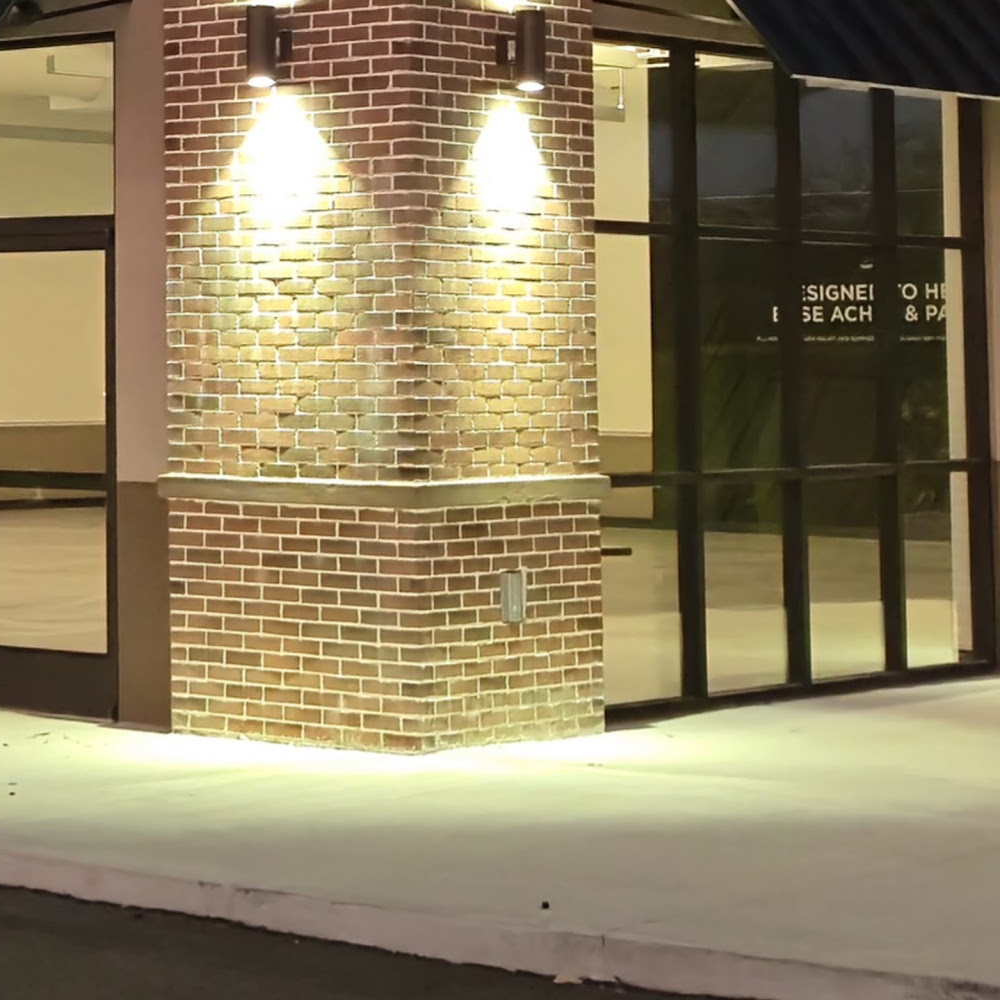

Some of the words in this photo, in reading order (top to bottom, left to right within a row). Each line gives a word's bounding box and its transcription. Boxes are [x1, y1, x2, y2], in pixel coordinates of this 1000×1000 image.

[801, 284, 874, 301] SIGNE
[897, 283, 918, 300] O
[830, 305, 873, 322] ACH
[904, 304, 919, 322] &
[925, 304, 946, 321] PA
